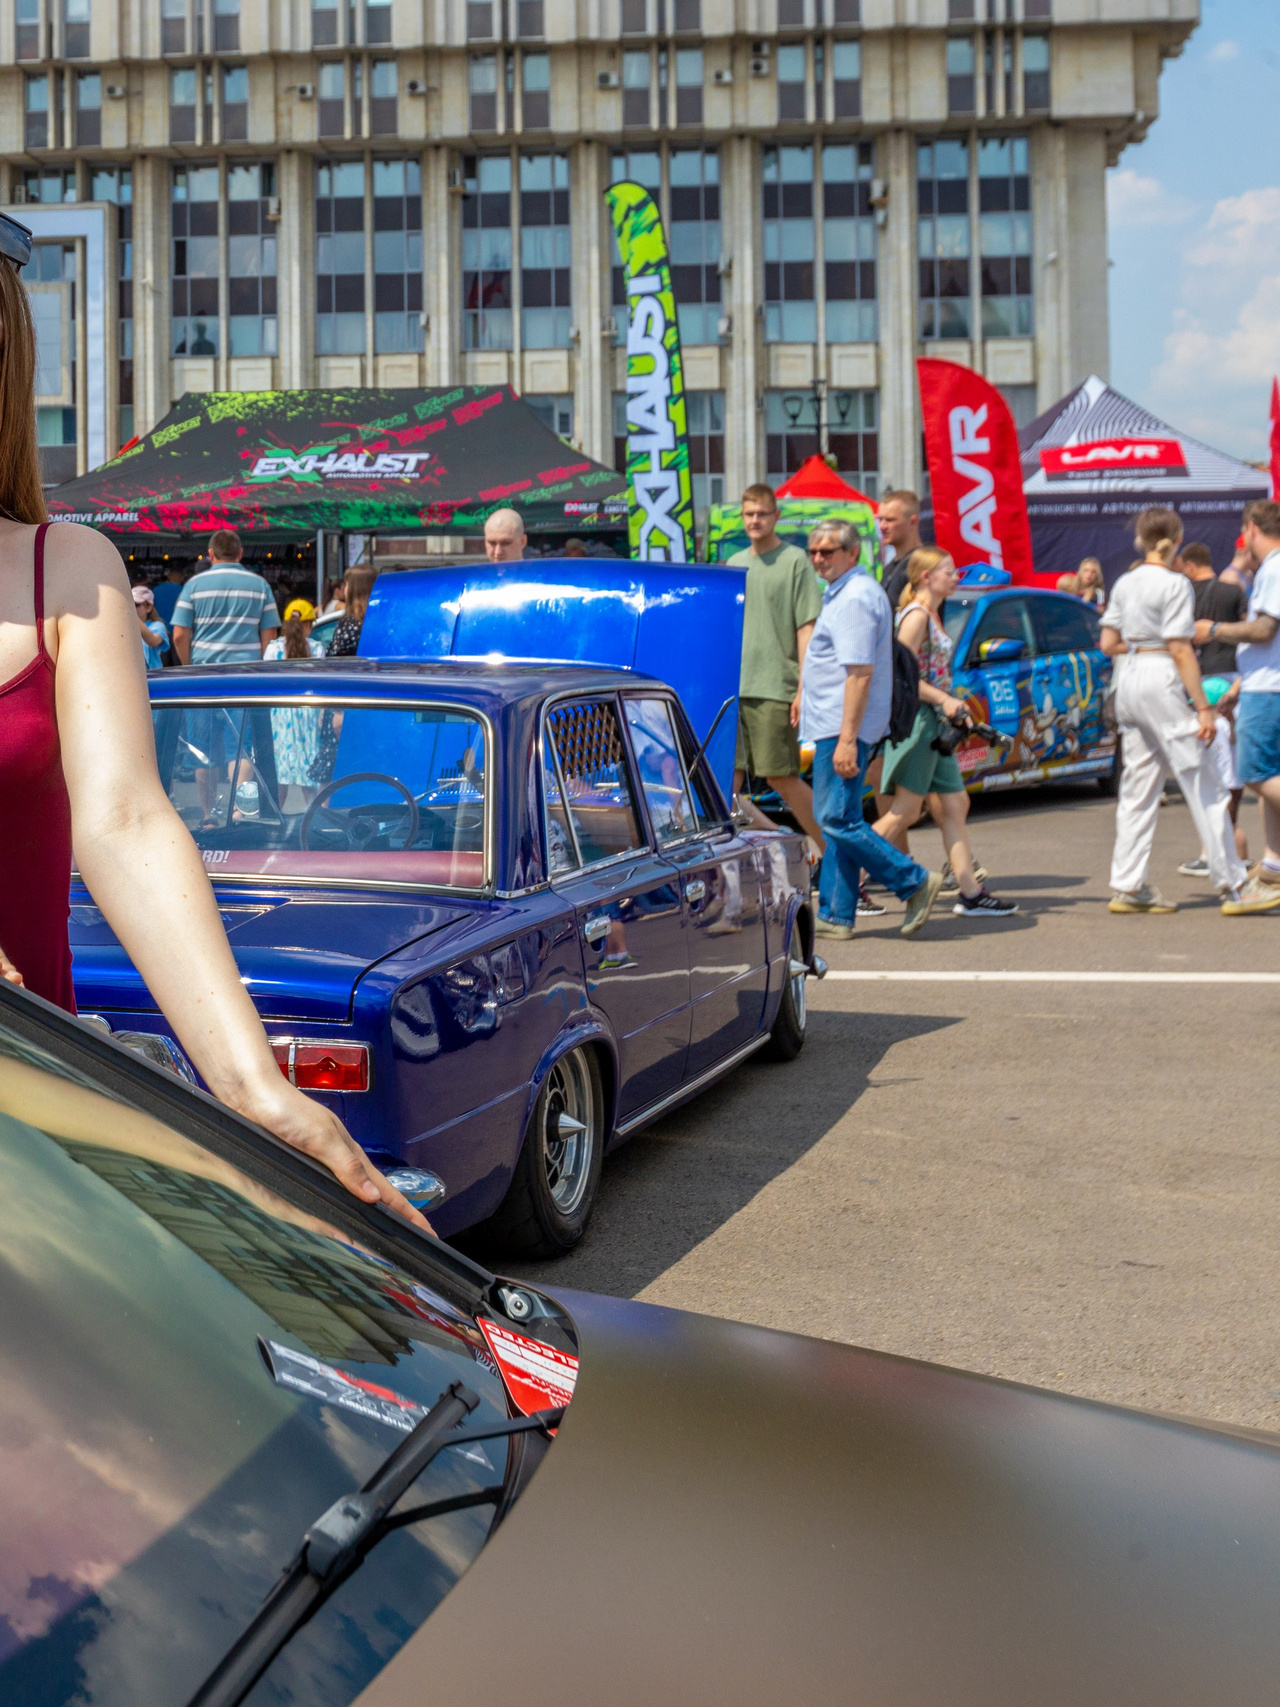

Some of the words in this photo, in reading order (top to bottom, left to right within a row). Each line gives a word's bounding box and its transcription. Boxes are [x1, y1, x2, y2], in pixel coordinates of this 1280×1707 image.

[1061, 444, 1160, 464] LAVR
[249, 451, 431, 478] EXHAUST
[95, 512, 139, 522] APPAREL
